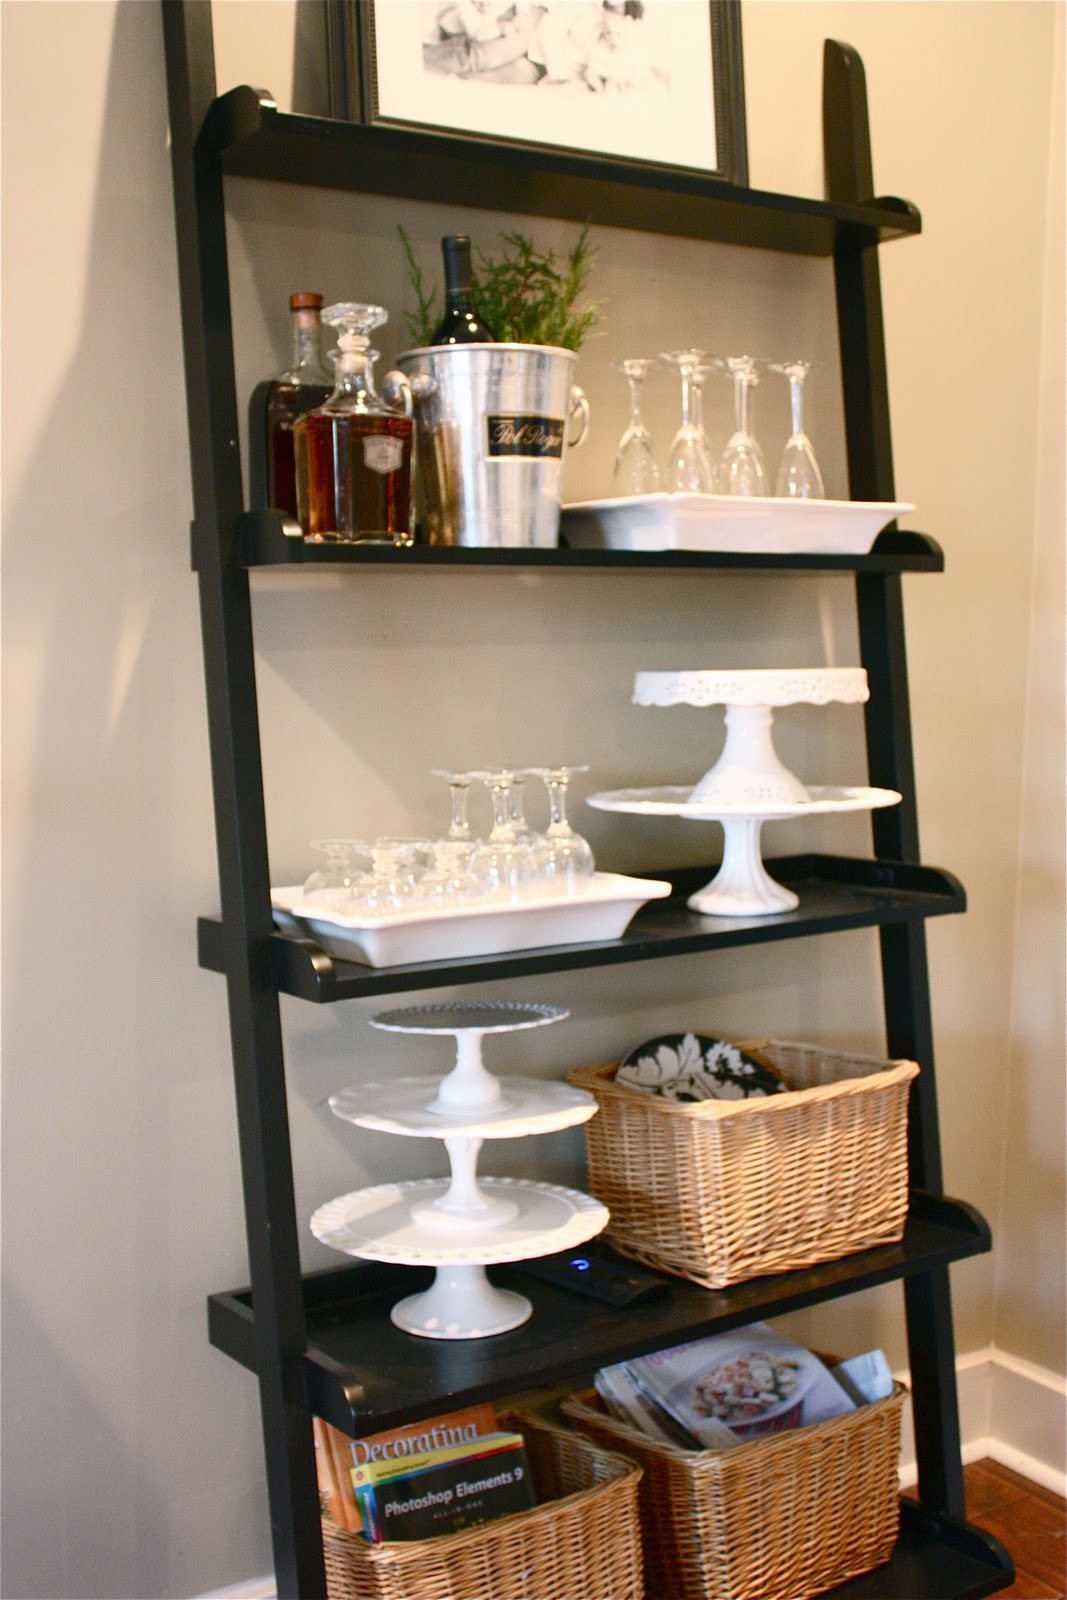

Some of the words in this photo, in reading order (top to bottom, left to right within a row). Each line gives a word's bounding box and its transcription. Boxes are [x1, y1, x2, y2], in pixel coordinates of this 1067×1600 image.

[384, 1489, 454, 1518] Photoshop
[455, 1471, 513, 1498] Elements
[513, 1466, 525, 1481] 9
